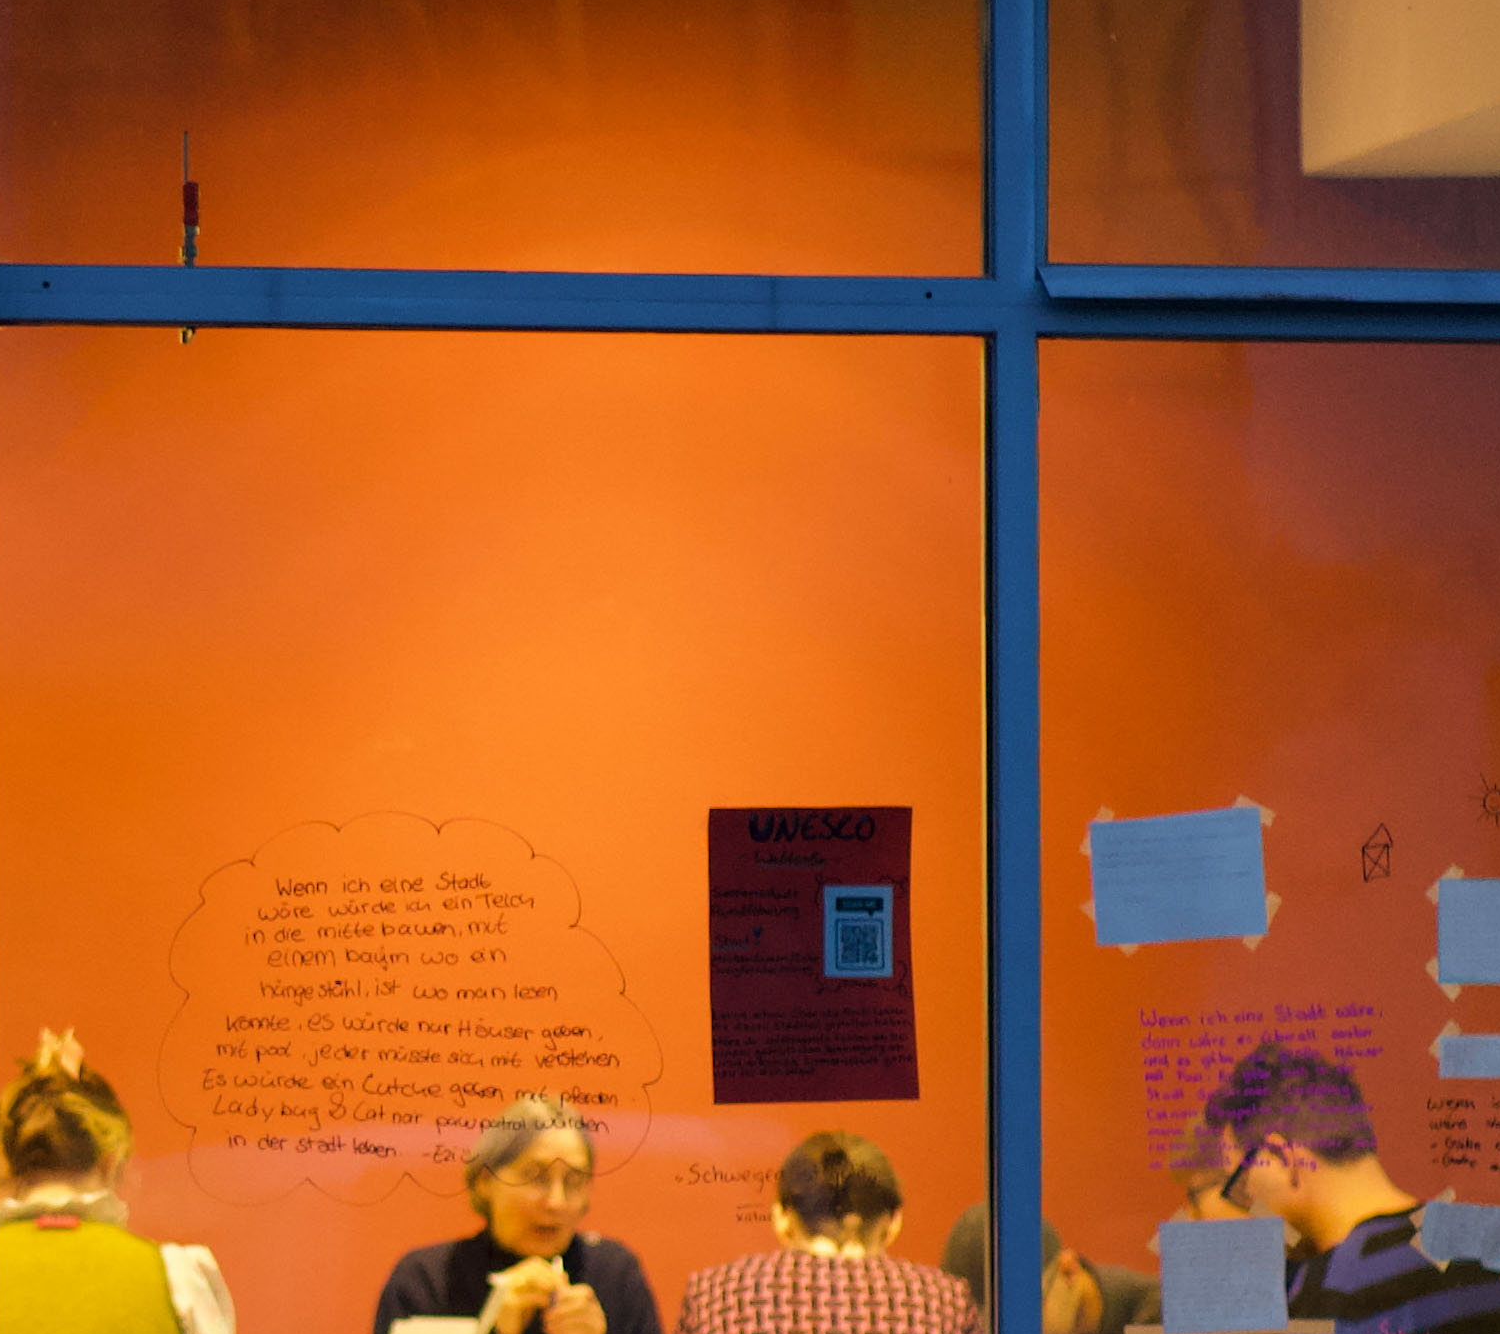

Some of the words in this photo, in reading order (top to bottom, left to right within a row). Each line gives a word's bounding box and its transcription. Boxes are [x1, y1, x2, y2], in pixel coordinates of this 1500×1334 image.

[749, 811, 876, 843] UNESCO
[276, 878, 328, 898] Wenn
[342, 878, 371, 893] ich
[379, 876, 424, 894] eine
[435, 872, 492, 892] Stadt
[328, 898, 396, 919] würde
[405, 898, 432, 913] ich
[442, 895, 473, 911] ein
[243, 928, 266, 946] in
[273, 924, 305, 944] die
[266, 948, 337, 967] einem
[419, 950, 460, 966] wo
[375, 979, 401, 996] ist
[411, 984, 449, 1002] wo
[307, 1012, 335, 1032] es
[342, 1011, 410, 1034] würde
[417, 1019, 452, 1035] nur
[1139, 1008, 1190, 1028] Wenn
[1200, 1010, 1227, 1024] ich
[1274, 1004, 1326, 1023] Stadt
[201, 1068, 228, 1090] Es
[232, 1070, 313, 1091] würde
[228, 1133, 247, 1150] in
[256, 1131, 288, 1152] der
